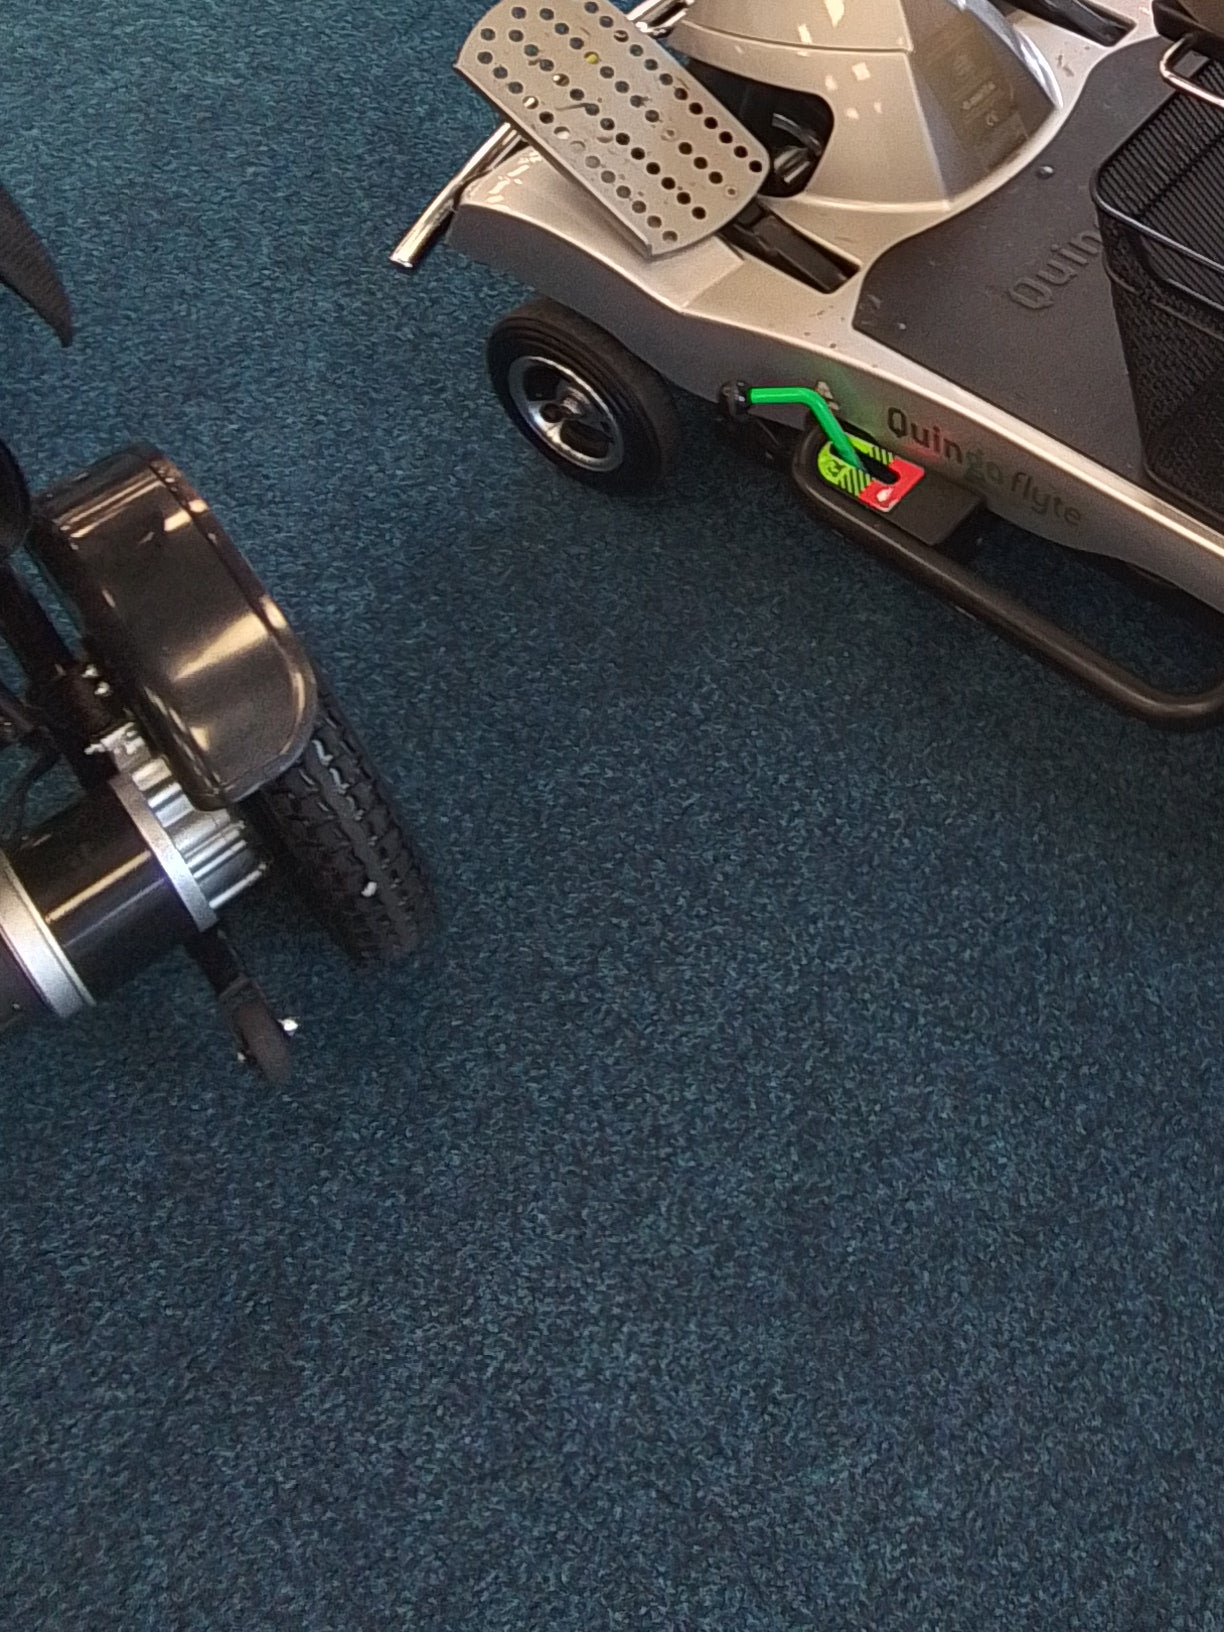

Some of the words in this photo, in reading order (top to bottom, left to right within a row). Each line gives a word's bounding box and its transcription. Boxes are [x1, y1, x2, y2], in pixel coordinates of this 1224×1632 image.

[1006, 226, 1103, 311] Quin
[886, 406, 1003, 484] Quingo
[1008, 471, 1082, 525] flyte
